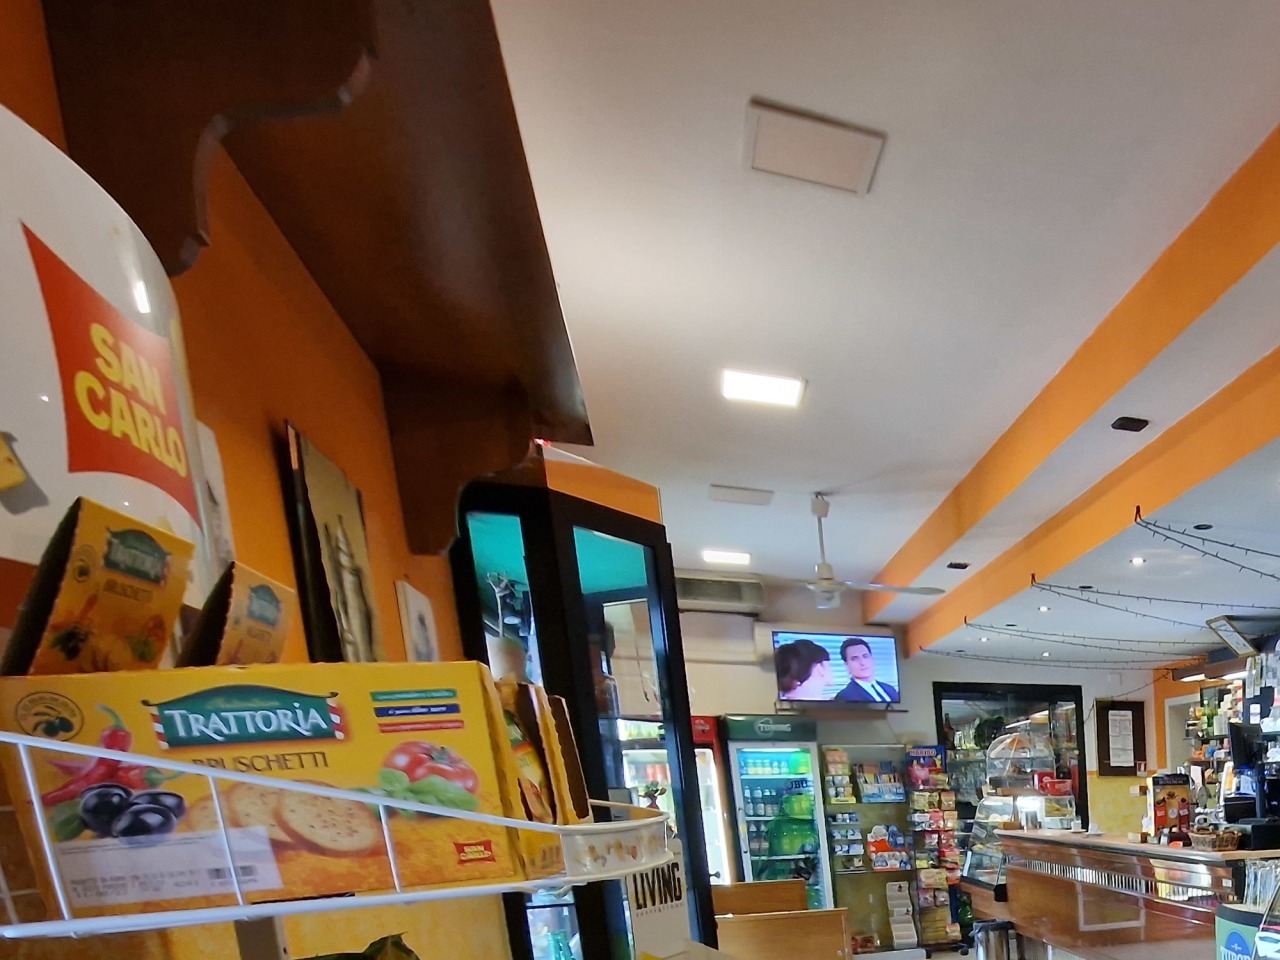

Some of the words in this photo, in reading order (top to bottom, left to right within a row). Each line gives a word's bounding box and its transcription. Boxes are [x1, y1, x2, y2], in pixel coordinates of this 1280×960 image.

[90, 322, 167, 416] SAN
[74, 370, 187, 478] CARLO
[633, 862, 684, 910] LIVING
